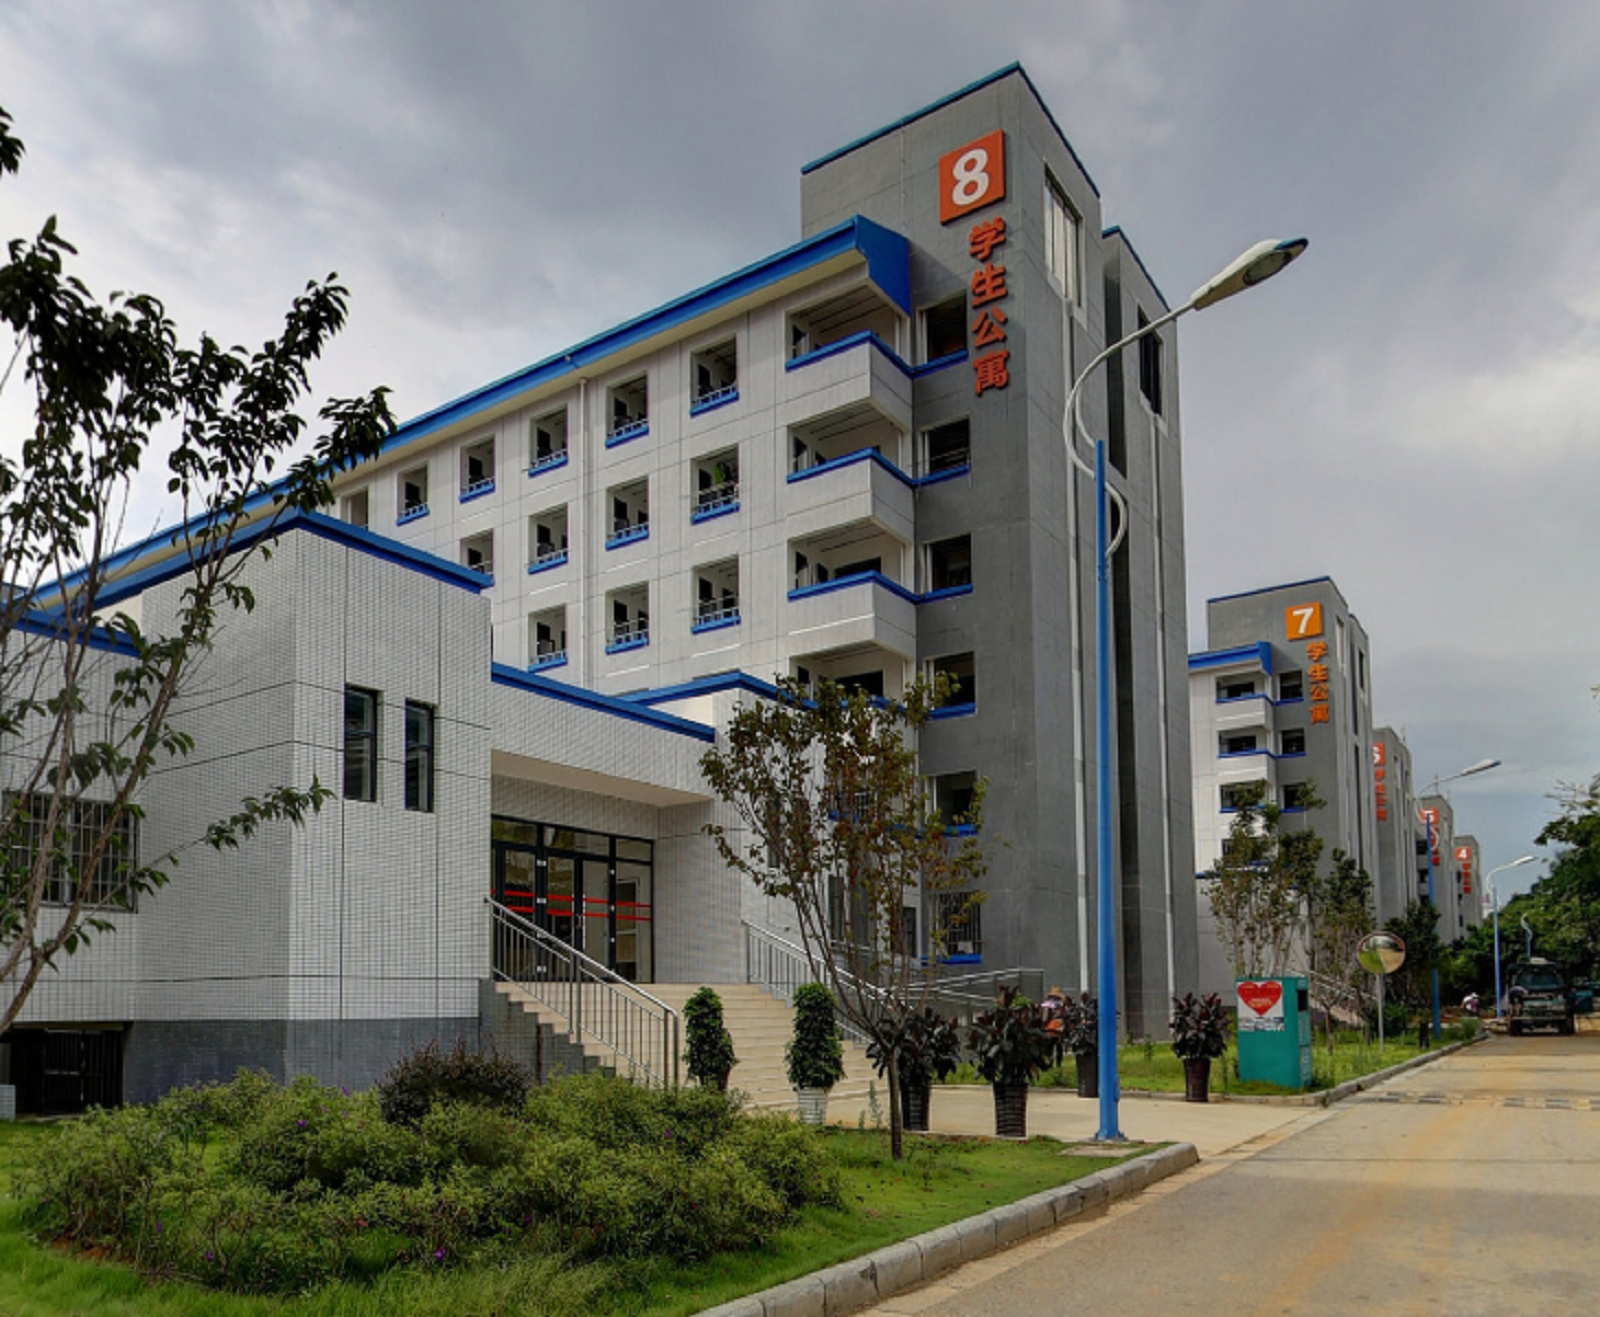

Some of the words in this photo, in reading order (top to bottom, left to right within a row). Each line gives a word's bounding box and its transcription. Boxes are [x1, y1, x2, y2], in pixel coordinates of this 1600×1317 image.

[952, 148, 989, 206] 8
[969, 216, 1010, 397] 学生公寓
[1292, 607, 1314, 634] 7
